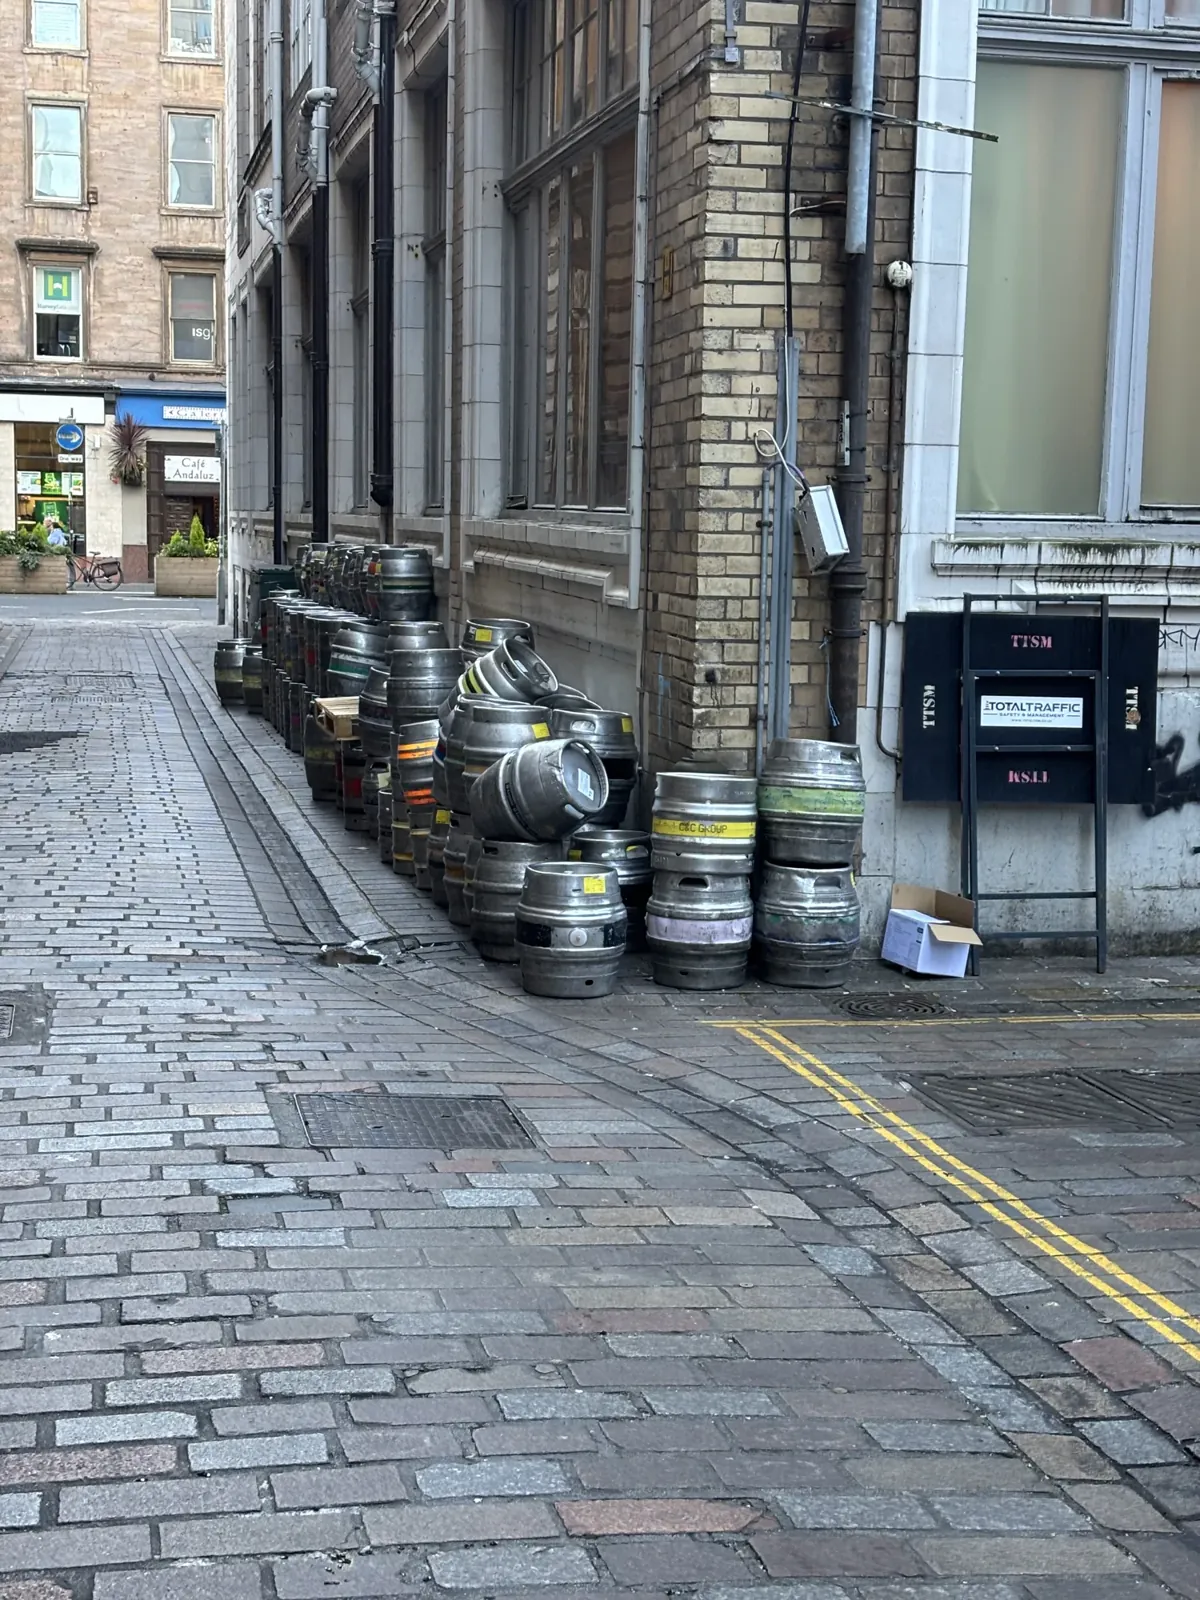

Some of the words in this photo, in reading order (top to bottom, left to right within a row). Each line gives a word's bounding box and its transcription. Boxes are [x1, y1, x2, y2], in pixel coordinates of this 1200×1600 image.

[181, 457, 206, 470] Café
[173, 469, 215, 480] Andaluz
[1010, 634, 1053, 649] TTSM
[922, 684, 936, 729] TTSM
[678, 822, 697, 833] C&C
[698, 823, 728, 834] GROUP
